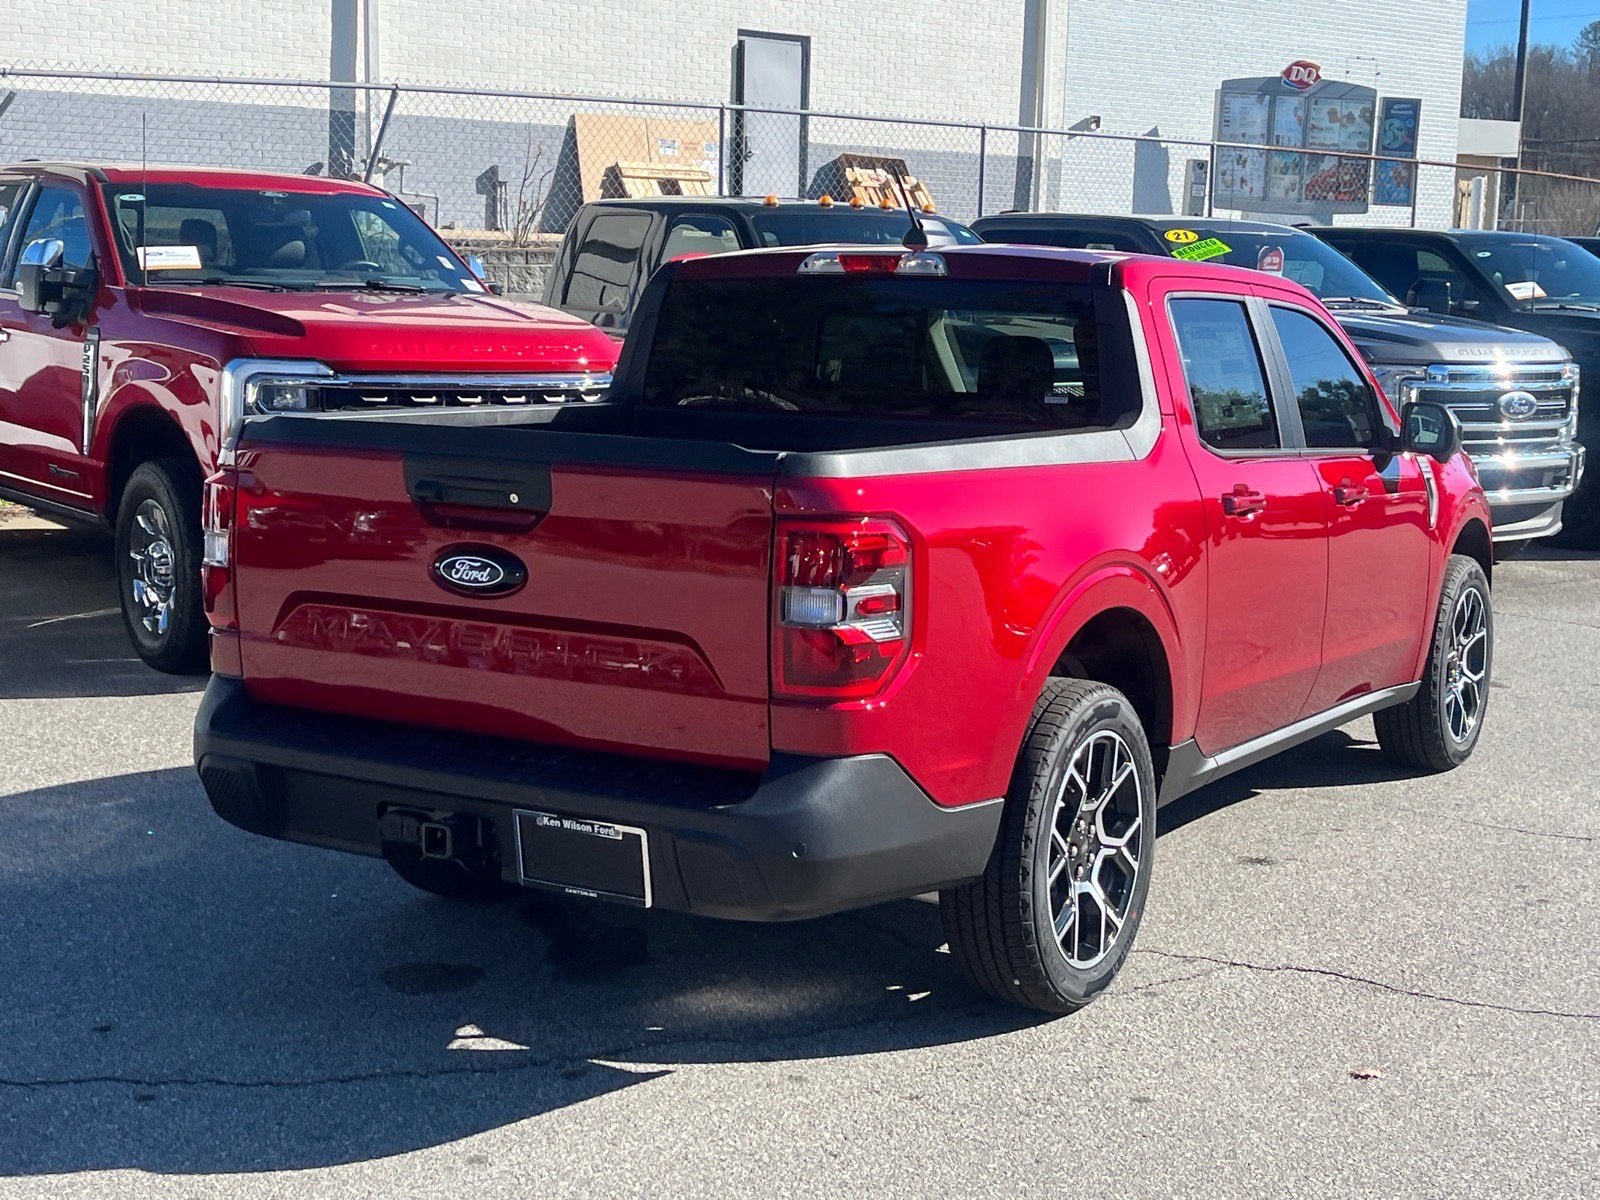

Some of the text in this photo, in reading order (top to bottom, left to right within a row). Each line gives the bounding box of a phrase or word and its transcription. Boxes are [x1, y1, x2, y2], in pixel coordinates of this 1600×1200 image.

[1289, 66, 1315, 84] DQ
[1173, 231, 1190, 241] 21
[1176, 240, 1218, 257] REDUCED
[1510, 396, 1529, 413] Ford
[452, 559, 491, 582] Ford
[304, 607, 688, 680] MAVERICK
[543, 816, 614, 836] Ken Wilson Ford
